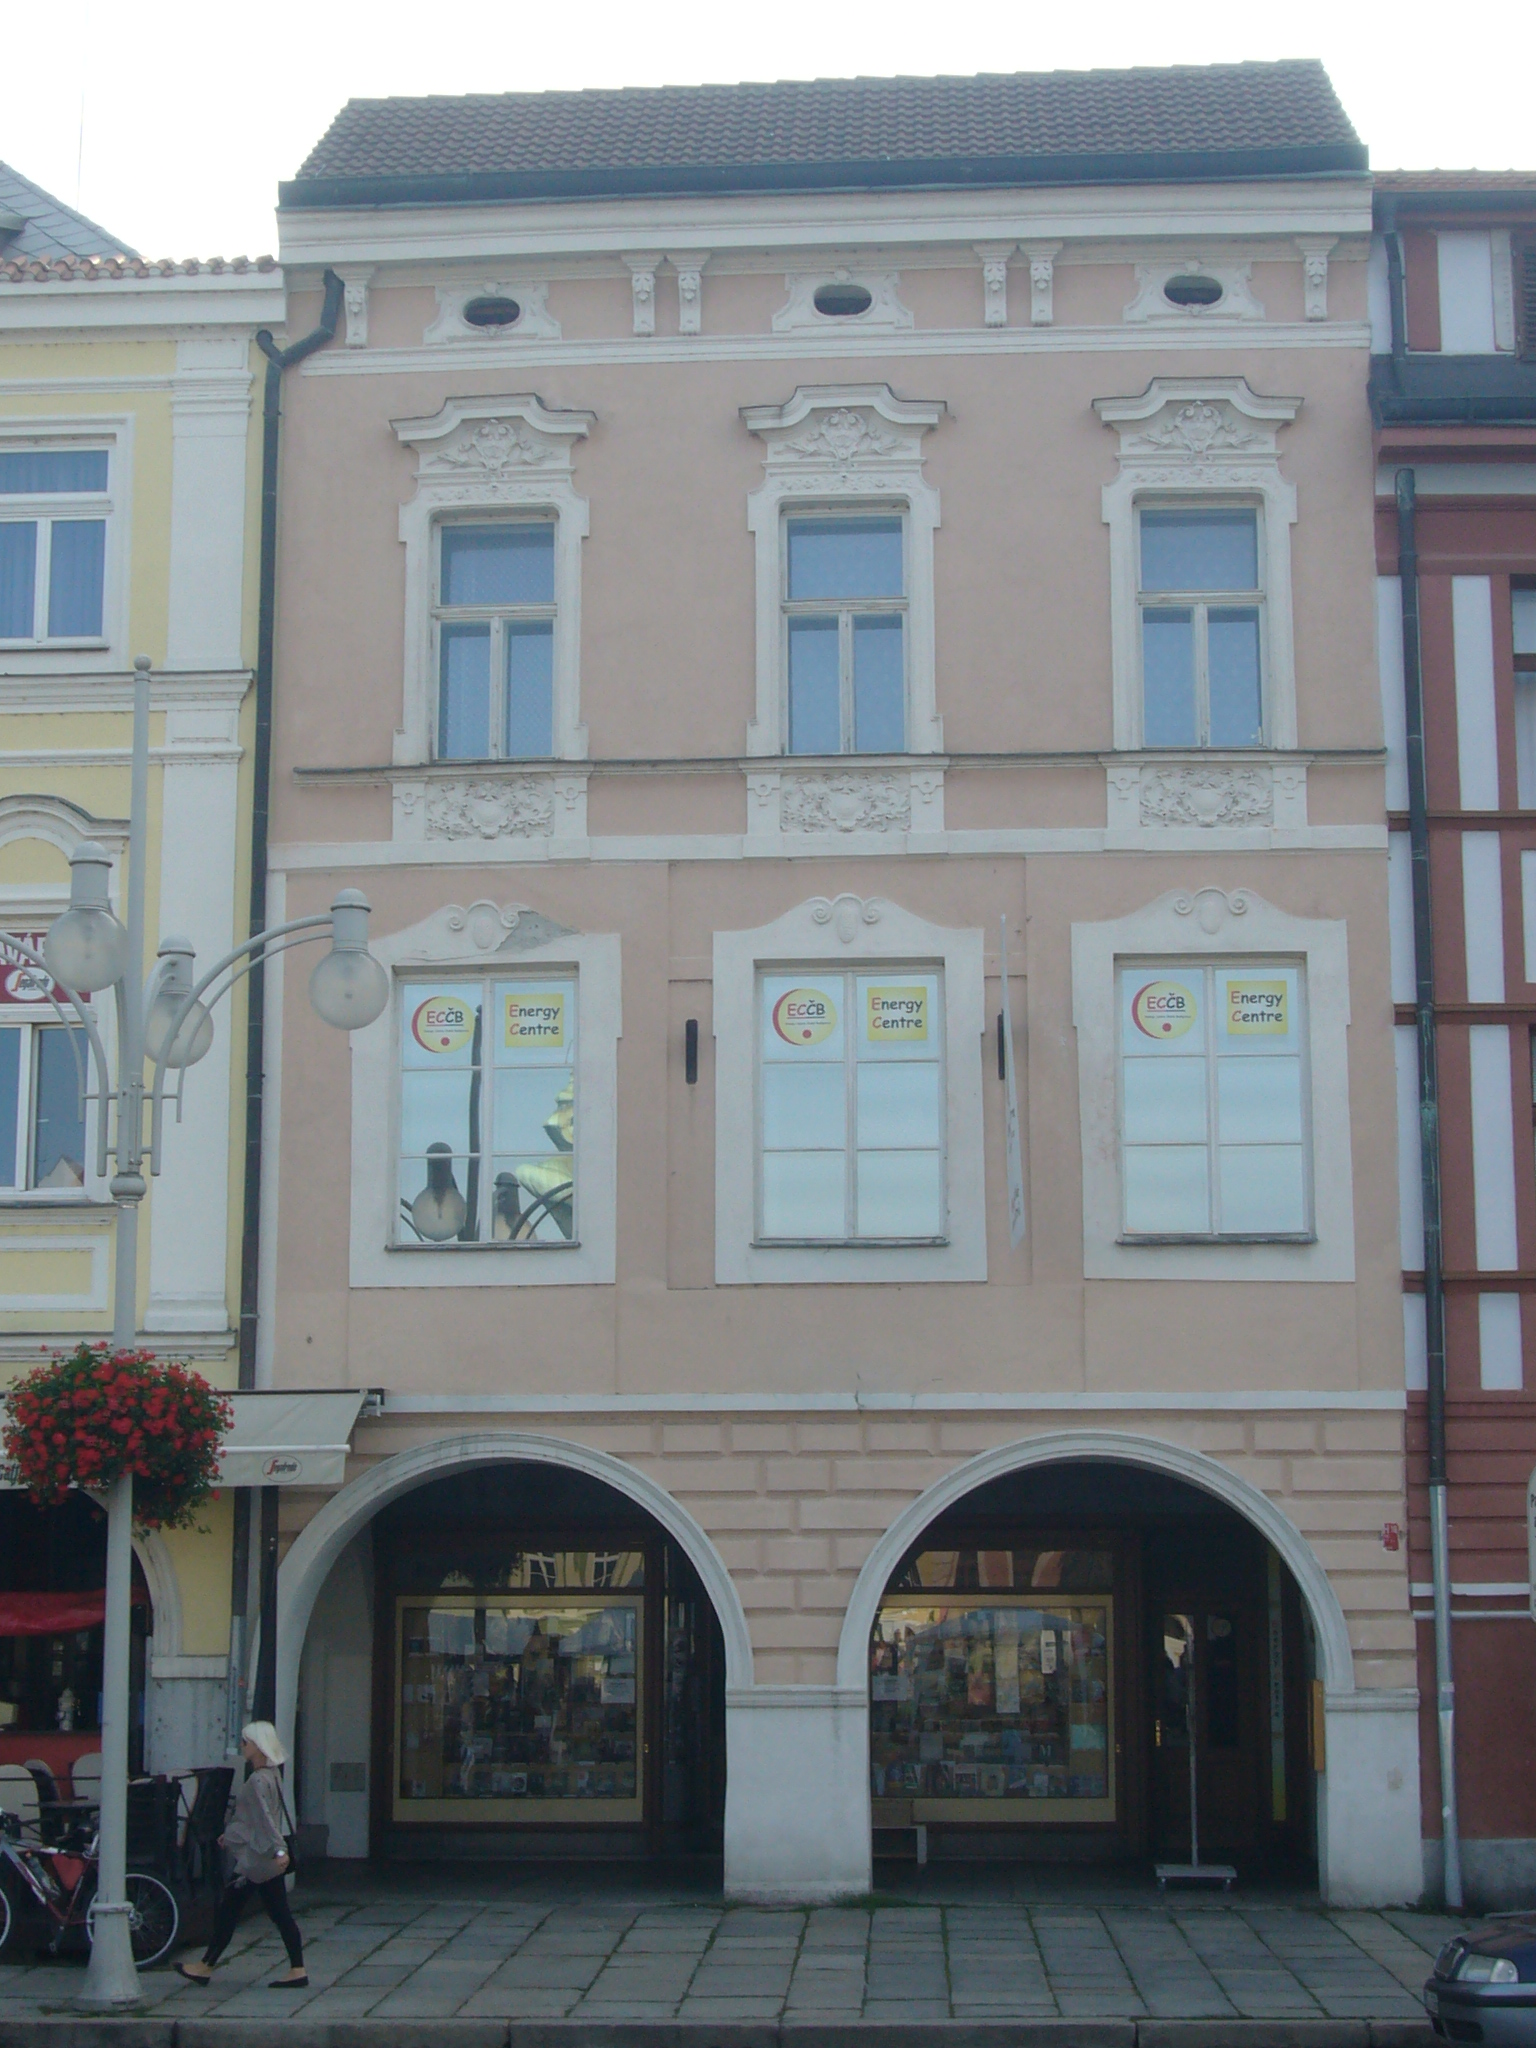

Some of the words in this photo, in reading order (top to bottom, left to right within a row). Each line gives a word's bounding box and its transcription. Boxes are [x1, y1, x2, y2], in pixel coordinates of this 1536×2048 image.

[872, 997, 923, 1013] Energy
[1147, 992, 1185, 1009] ECČB
[1231, 990, 1282, 1007] Energy
[426, 1007, 464, 1023] ECČB
[509, 1004, 560, 1020] Energy
[787, 1000, 825, 1016] ECČB
[1231, 1010, 1283, 1022] Centre
[509, 1023, 560, 1035] Centre
[872, 1016, 923, 1029] Centre
